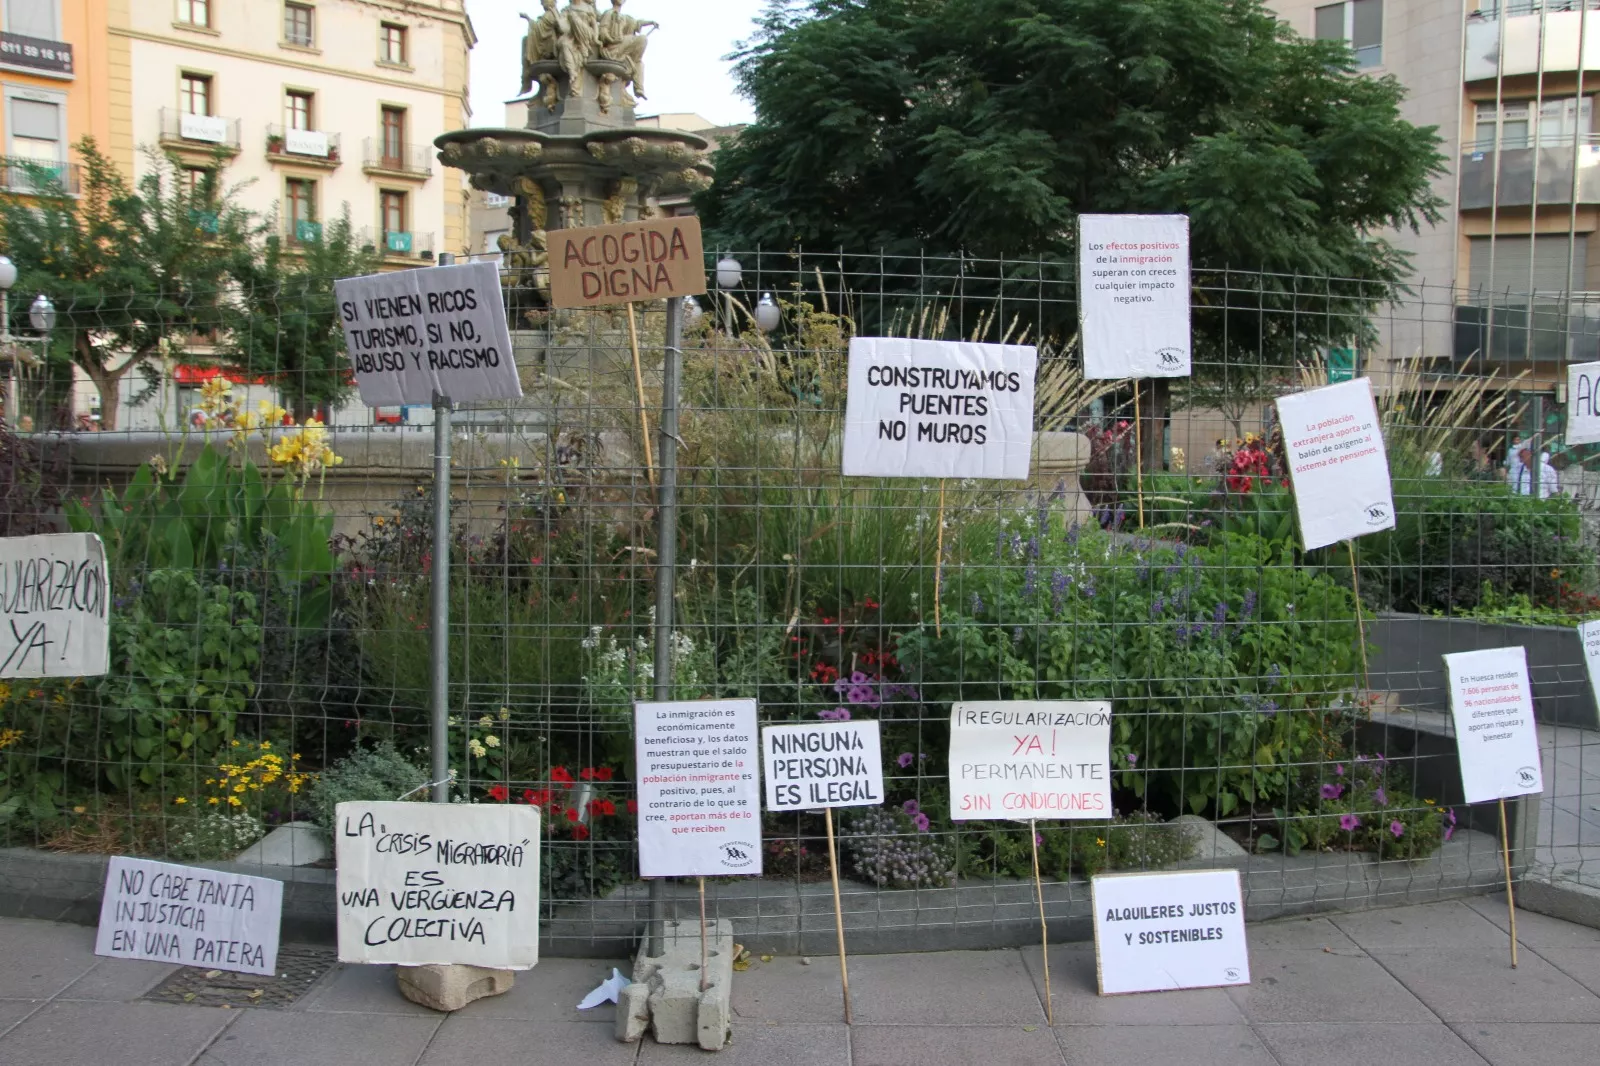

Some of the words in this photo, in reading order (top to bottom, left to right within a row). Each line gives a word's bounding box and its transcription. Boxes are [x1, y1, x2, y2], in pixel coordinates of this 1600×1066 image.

[564, 227, 689, 269] ACOGIDA
[1106, 242, 1137, 250] efectos
[1140, 242, 1180, 251] positivos
[1120, 255, 1172, 265] inmigración
[582, 262, 673, 299] DIGNA
[1092, 269, 1128, 278] superan
[1095, 282, 1136, 291] cualquier
[1139, 281, 1174, 291] impacto
[342, 301, 359, 322] SI
[365, 294, 421, 319] VIENEN
[428, 288, 477, 314] RICOS
[1114, 295, 1154, 304] negativo.
[350, 324, 424, 350] TURISMO,
[428, 323, 443, 344] SI
[450, 320, 481, 344] NO,
[356, 352, 404, 374] ABUSO
[410, 352, 421, 370] Y
[428, 347, 500, 370] RACISMO
[868, 366, 1020, 392] CONSTRUYAMOS
[900, 393, 988, 416] PUENTES
[1306, 424, 1315, 432] La
[1318, 414, 1354, 430] población
[879, 420, 906, 441] NO
[918, 422, 987, 444] MUROS
[1292, 432, 1334, 448] extranjera
[1336, 425, 1360, 438] aporta
[1362, 422, 1372, 430] un
[1299, 448, 1320, 459] balón
[1323, 445, 1332, 453] de
[1334, 438, 1363, 450] oxígeno
[1365, 434, 1372, 442] al
[1296, 460, 1326, 473] sistema
[1329, 457, 1338, 465] de
[1471, 674, 1494, 682] Huesca
[1481, 685, 1509, 695] personas
[1474, 696, 1521, 706] nacionalidades
[669, 709, 722, 720] inmigración
[1472, 709, 1504, 718] diferentes
[1506, 708, 1518, 716] que
[657, 722, 735, 732] económicamente
[1469, 722, 1494, 732] aportan
[1496, 720, 1518, 728] riqueza
[644, 736, 695, 744] beneficiosa
[698, 737, 705, 745] y,
[772, 730, 863, 754] NINGUNA
[1483, 732, 1513, 741] bienestar
[712, 747, 720, 755] el
[722, 747, 747, 755] saldo
[651, 760, 719, 772] presupuestario
[774, 756, 867, 779] PERSONA
[962, 764, 1103, 780] PERMANENTE
[643, 774, 686, 784] población
[689, 773, 740, 782] inmigrante
[660, 787, 698, 797] positivo,
[701, 787, 724, 796] pues,
[775, 785, 801, 805] ES
[810, 780, 877, 803] ILEGAL
[718, 800, 735, 808] que
[960, 794, 991, 811] SIN
[1002, 792, 1104, 811] CONDICIONES
[346, 812, 375, 837] LA
[670, 812, 706, 822] aportan
[708, 811, 727, 819] más
[672, 827, 688, 835] que
[691, 825, 725, 833] reciben
[405, 871, 444, 887] ES
[119, 869, 144, 895] NO
[150, 873, 193, 901] CABE
[197, 879, 254, 911] TANTA
[342, 888, 379, 907] UNA
[391, 889, 515, 912] VERGÜENZA
[1106, 905, 1184, 922] ALQUILERES
[1189, 902, 1236, 917] JUSTOS
[365, 916, 485, 946] COLECTIVA
[1125, 933, 1132, 946] Y
[1139, 927, 1223, 945] SOSTENIBLES
[112, 930, 136, 951] EN
[145, 932, 180, 958] UNA
[193, 938, 264, 968] PATERA
